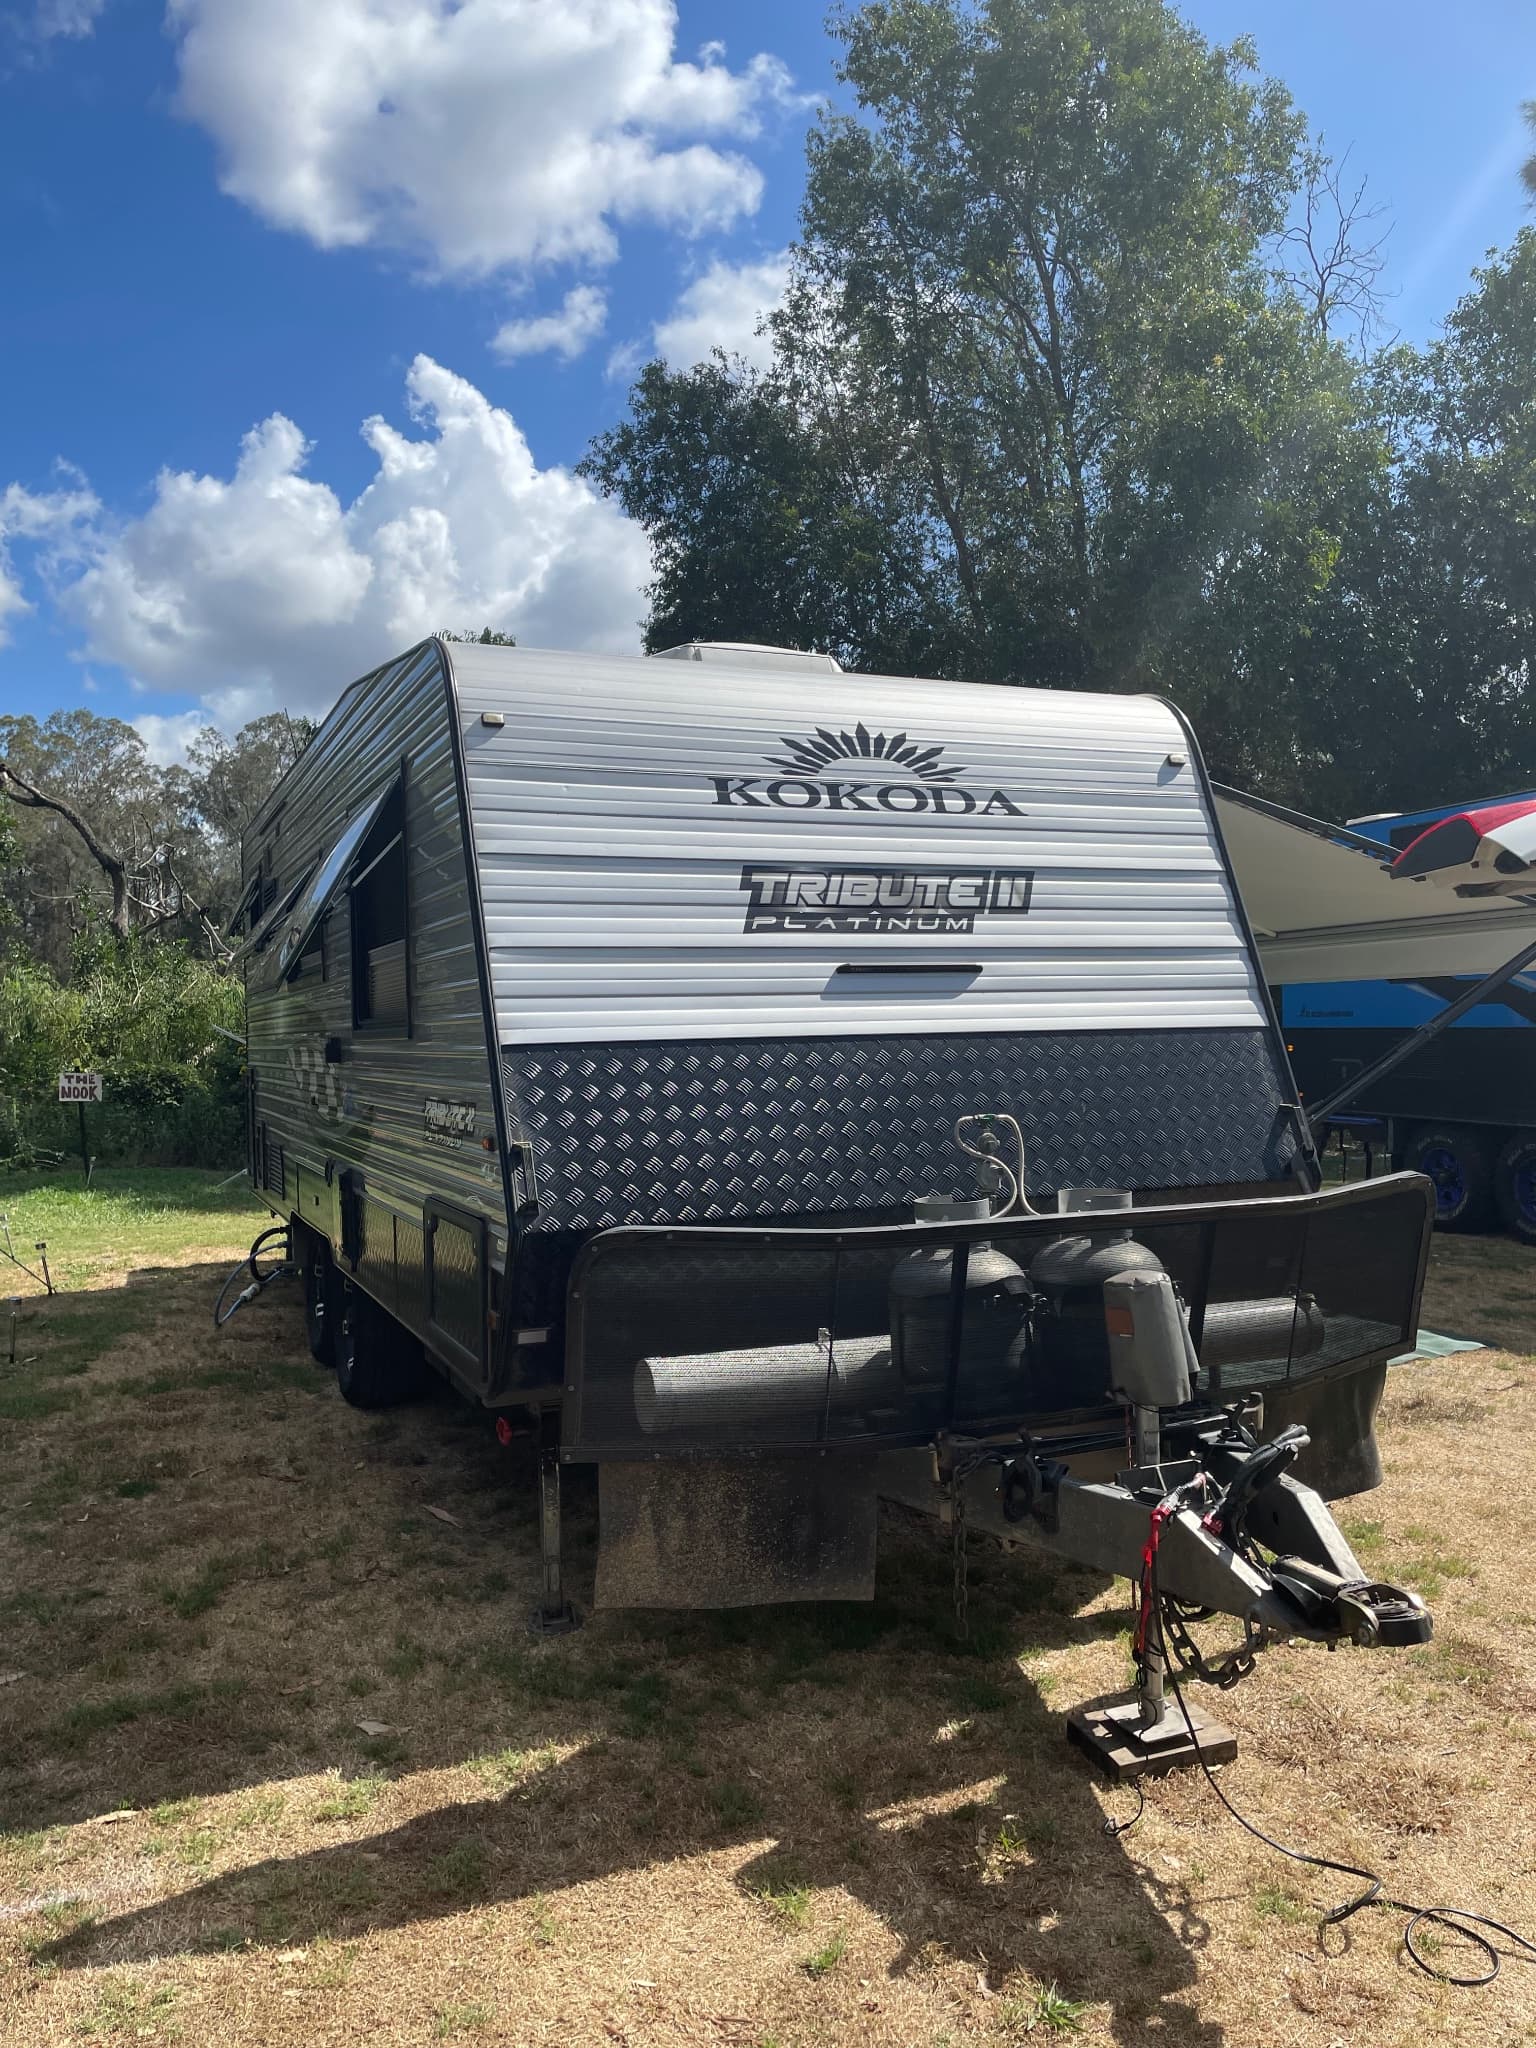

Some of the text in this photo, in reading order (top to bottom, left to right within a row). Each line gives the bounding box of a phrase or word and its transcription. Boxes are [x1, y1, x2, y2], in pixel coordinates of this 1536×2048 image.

[708, 777, 1029, 817] KOKODA
[750, 872, 983, 907] TRIBUTE
[751, 915, 969, 931] PLATINUM
[64, 1074, 95, 1084] THE
[61, 1086, 97, 1100] NOOK
